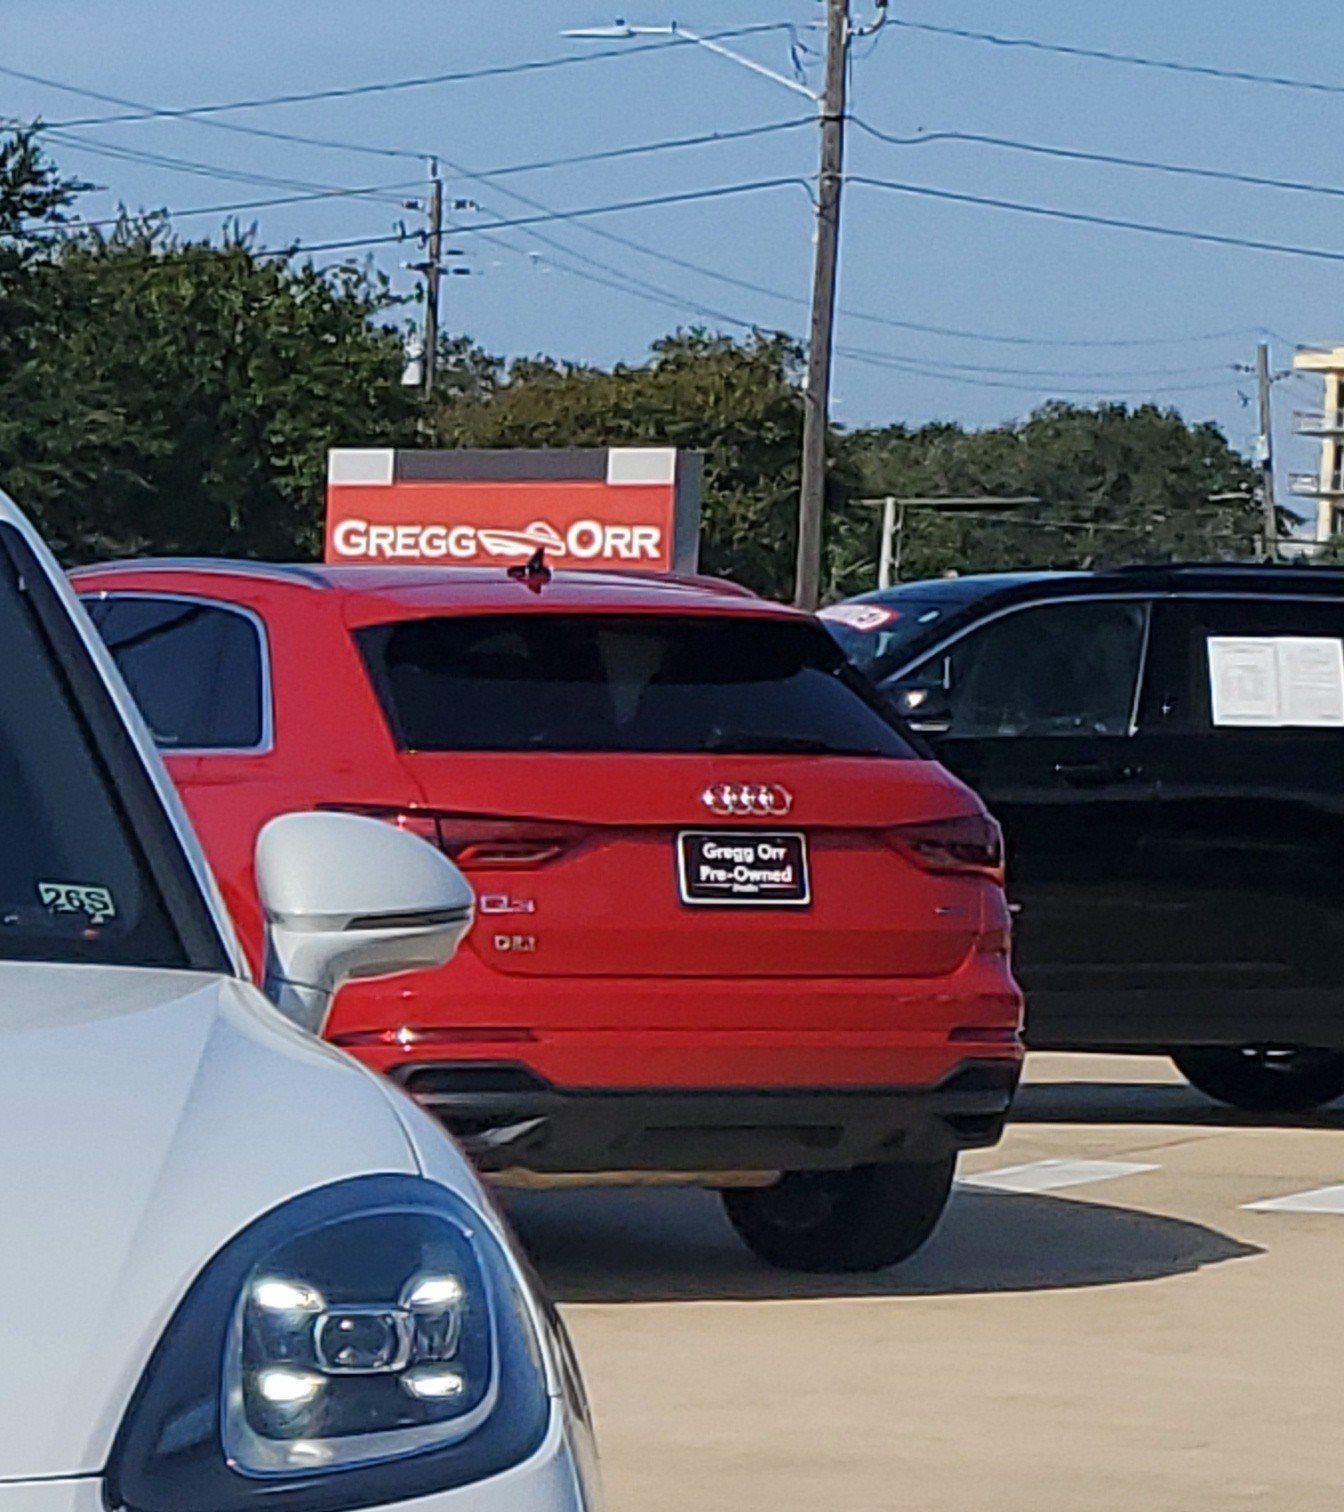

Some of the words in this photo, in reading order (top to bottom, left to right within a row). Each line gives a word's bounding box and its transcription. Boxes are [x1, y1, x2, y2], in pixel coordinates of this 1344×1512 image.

[333, 519, 478, 560] GREGG
[567, 519, 662, 560] ORR
[702, 842, 754, 863] Gregg
[757, 843, 787, 861] Orr
[700, 864, 793, 883] Pre-Owned
